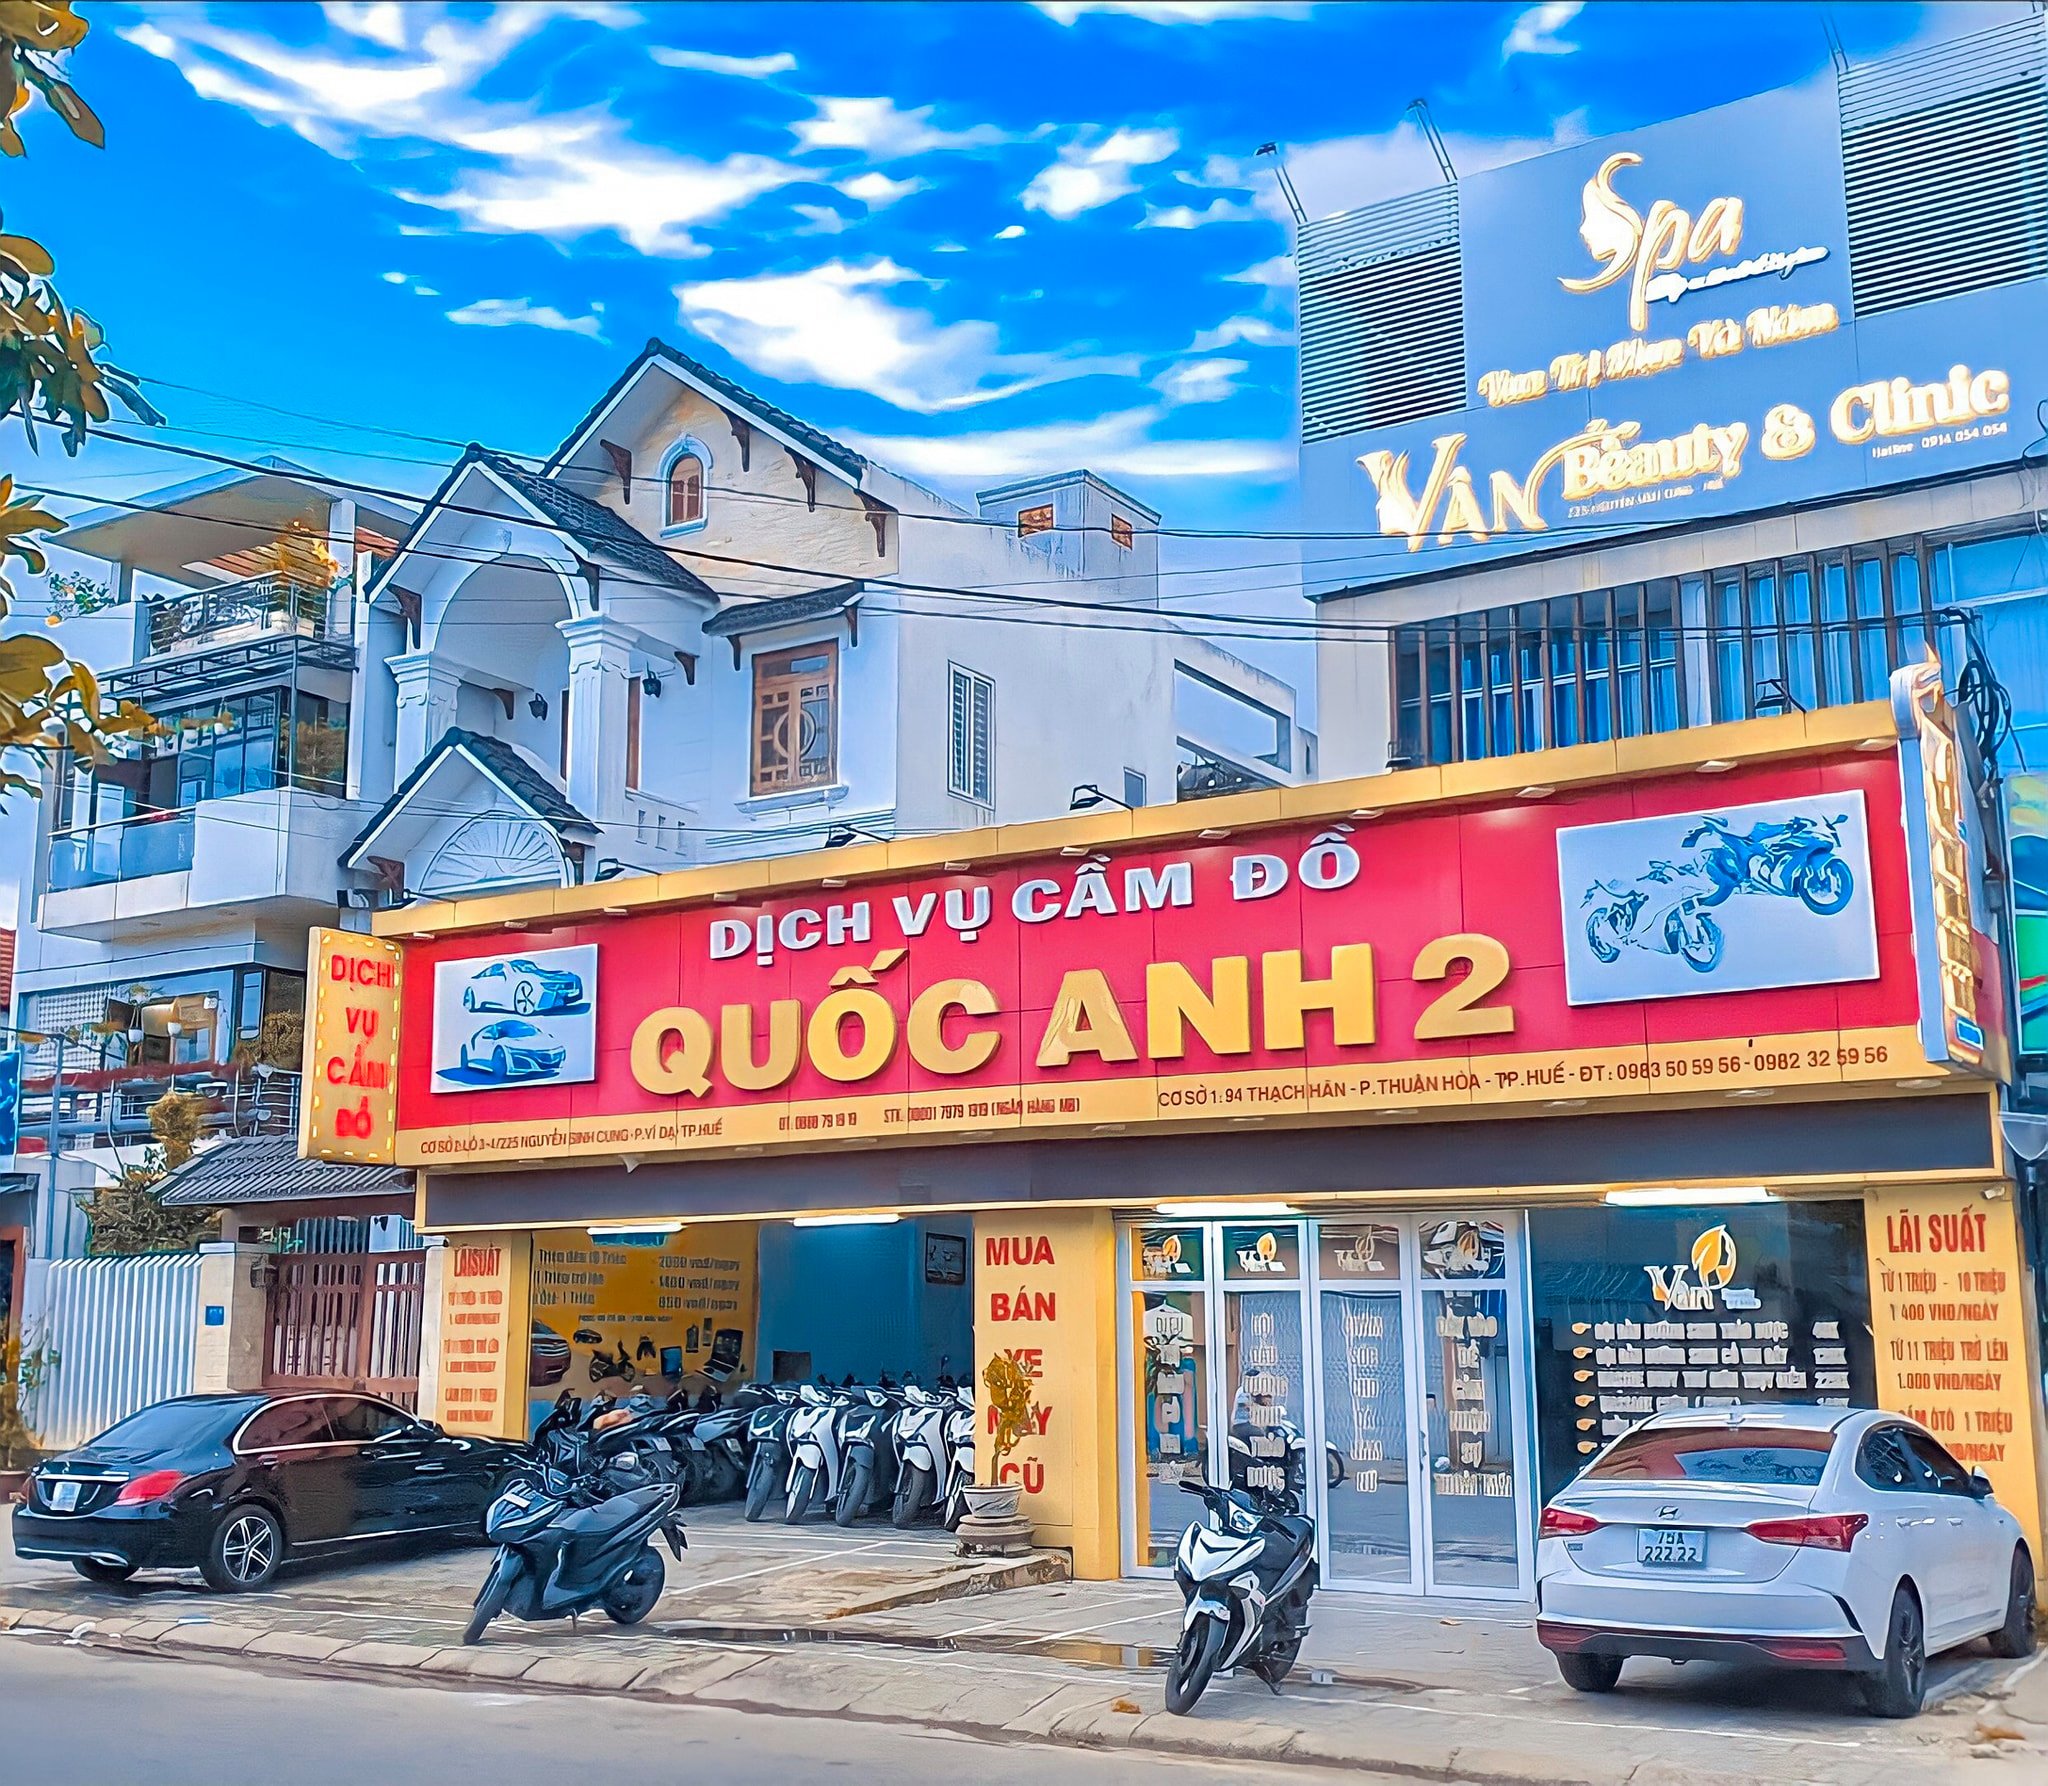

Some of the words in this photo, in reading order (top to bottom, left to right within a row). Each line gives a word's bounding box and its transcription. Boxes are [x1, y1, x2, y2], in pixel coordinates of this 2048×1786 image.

[1557, 152, 1744, 332] Spa
[1562, 421, 1749, 499] Beauty
[1760, 402, 1816, 461] &
[1829, 364, 2010, 444] Clinic
[709, 901, 872, 967] DỊCH
[892, 885, 993, 943] VỤ
[1011, 853, 1193, 925] CẦM
[1229, 823, 1361, 901] ĐỒ
[629, 948, 1002, 1099] QUỐC
[1035, 942, 1378, 1068] ANH
[1410, 932, 1516, 1041] 2
[1158, 1091, 1182, 1106] CƠ
[1185, 1084, 1207, 1105] SỞ
[1225, 1088, 1243, 1103] 94
[1247, 1085, 1305, 1104] THẠCH
[1442, 1070, 1481, 1092] HÒA
[1616, 1061, 1661, 1081] 0983
[1666, 1060, 1687, 1077] 50
[1692, 1058, 1713, 1076] 59
[1807, 1050, 1831, 1067] 32
[1836, 1048, 1859, 1065] 59
[1864, 1046, 1888, 1064] 56
[985, 1236, 1055, 1266] MUA
[1886, 1210, 1922, 1253] LÃI
[1928, 1204, 1987, 1253] SUẤT
[991, 1285, 1056, 1322] BÁN
